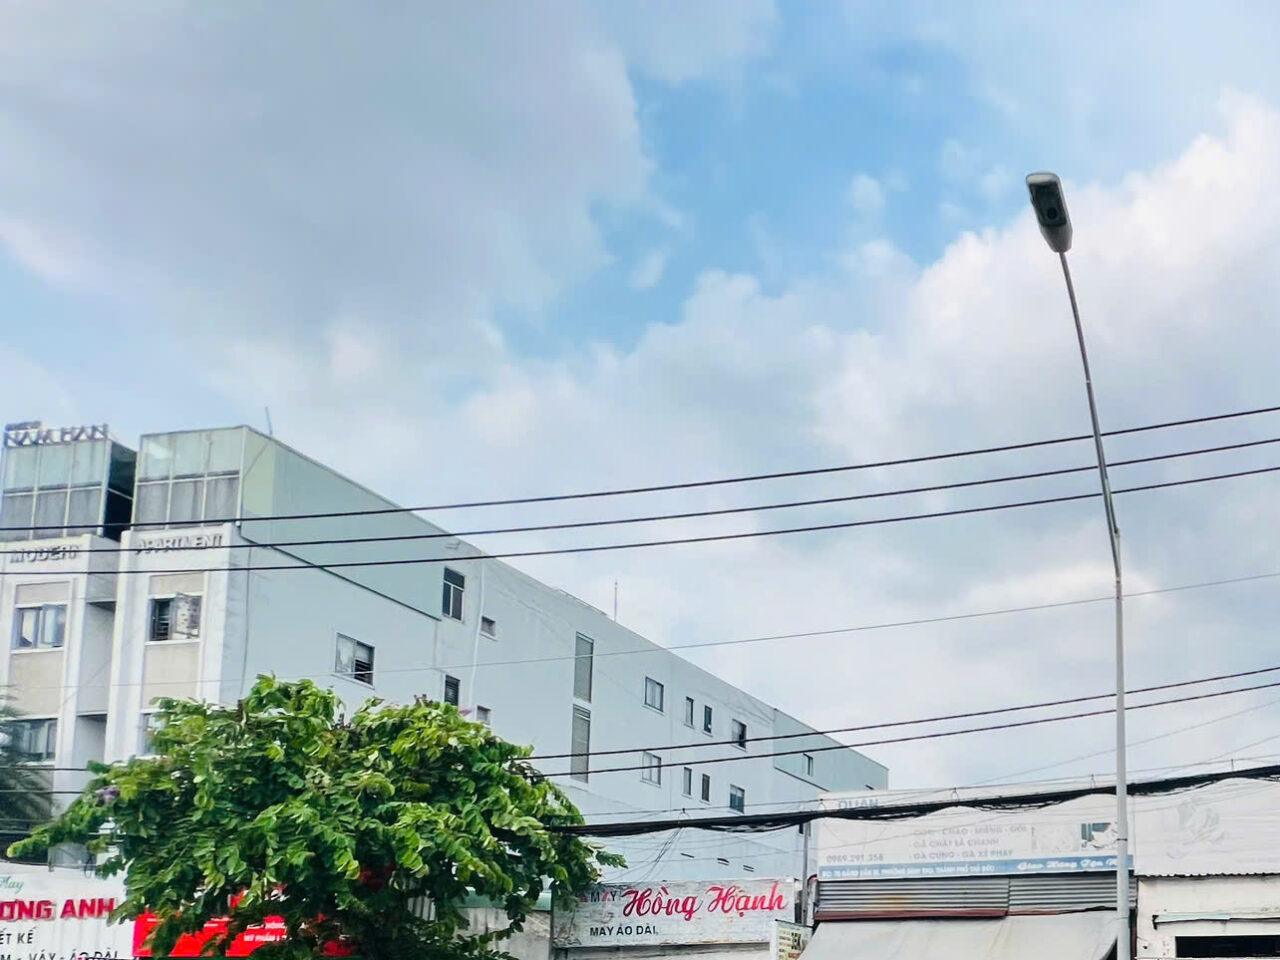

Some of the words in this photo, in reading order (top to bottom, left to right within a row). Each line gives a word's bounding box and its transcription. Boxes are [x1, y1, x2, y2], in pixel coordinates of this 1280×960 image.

[60, 897, 116, 919] ANH
[621, 884, 700, 921] Hồng
[705, 880, 788, 918] Hạnh
[589, 926, 614, 937] MAY
